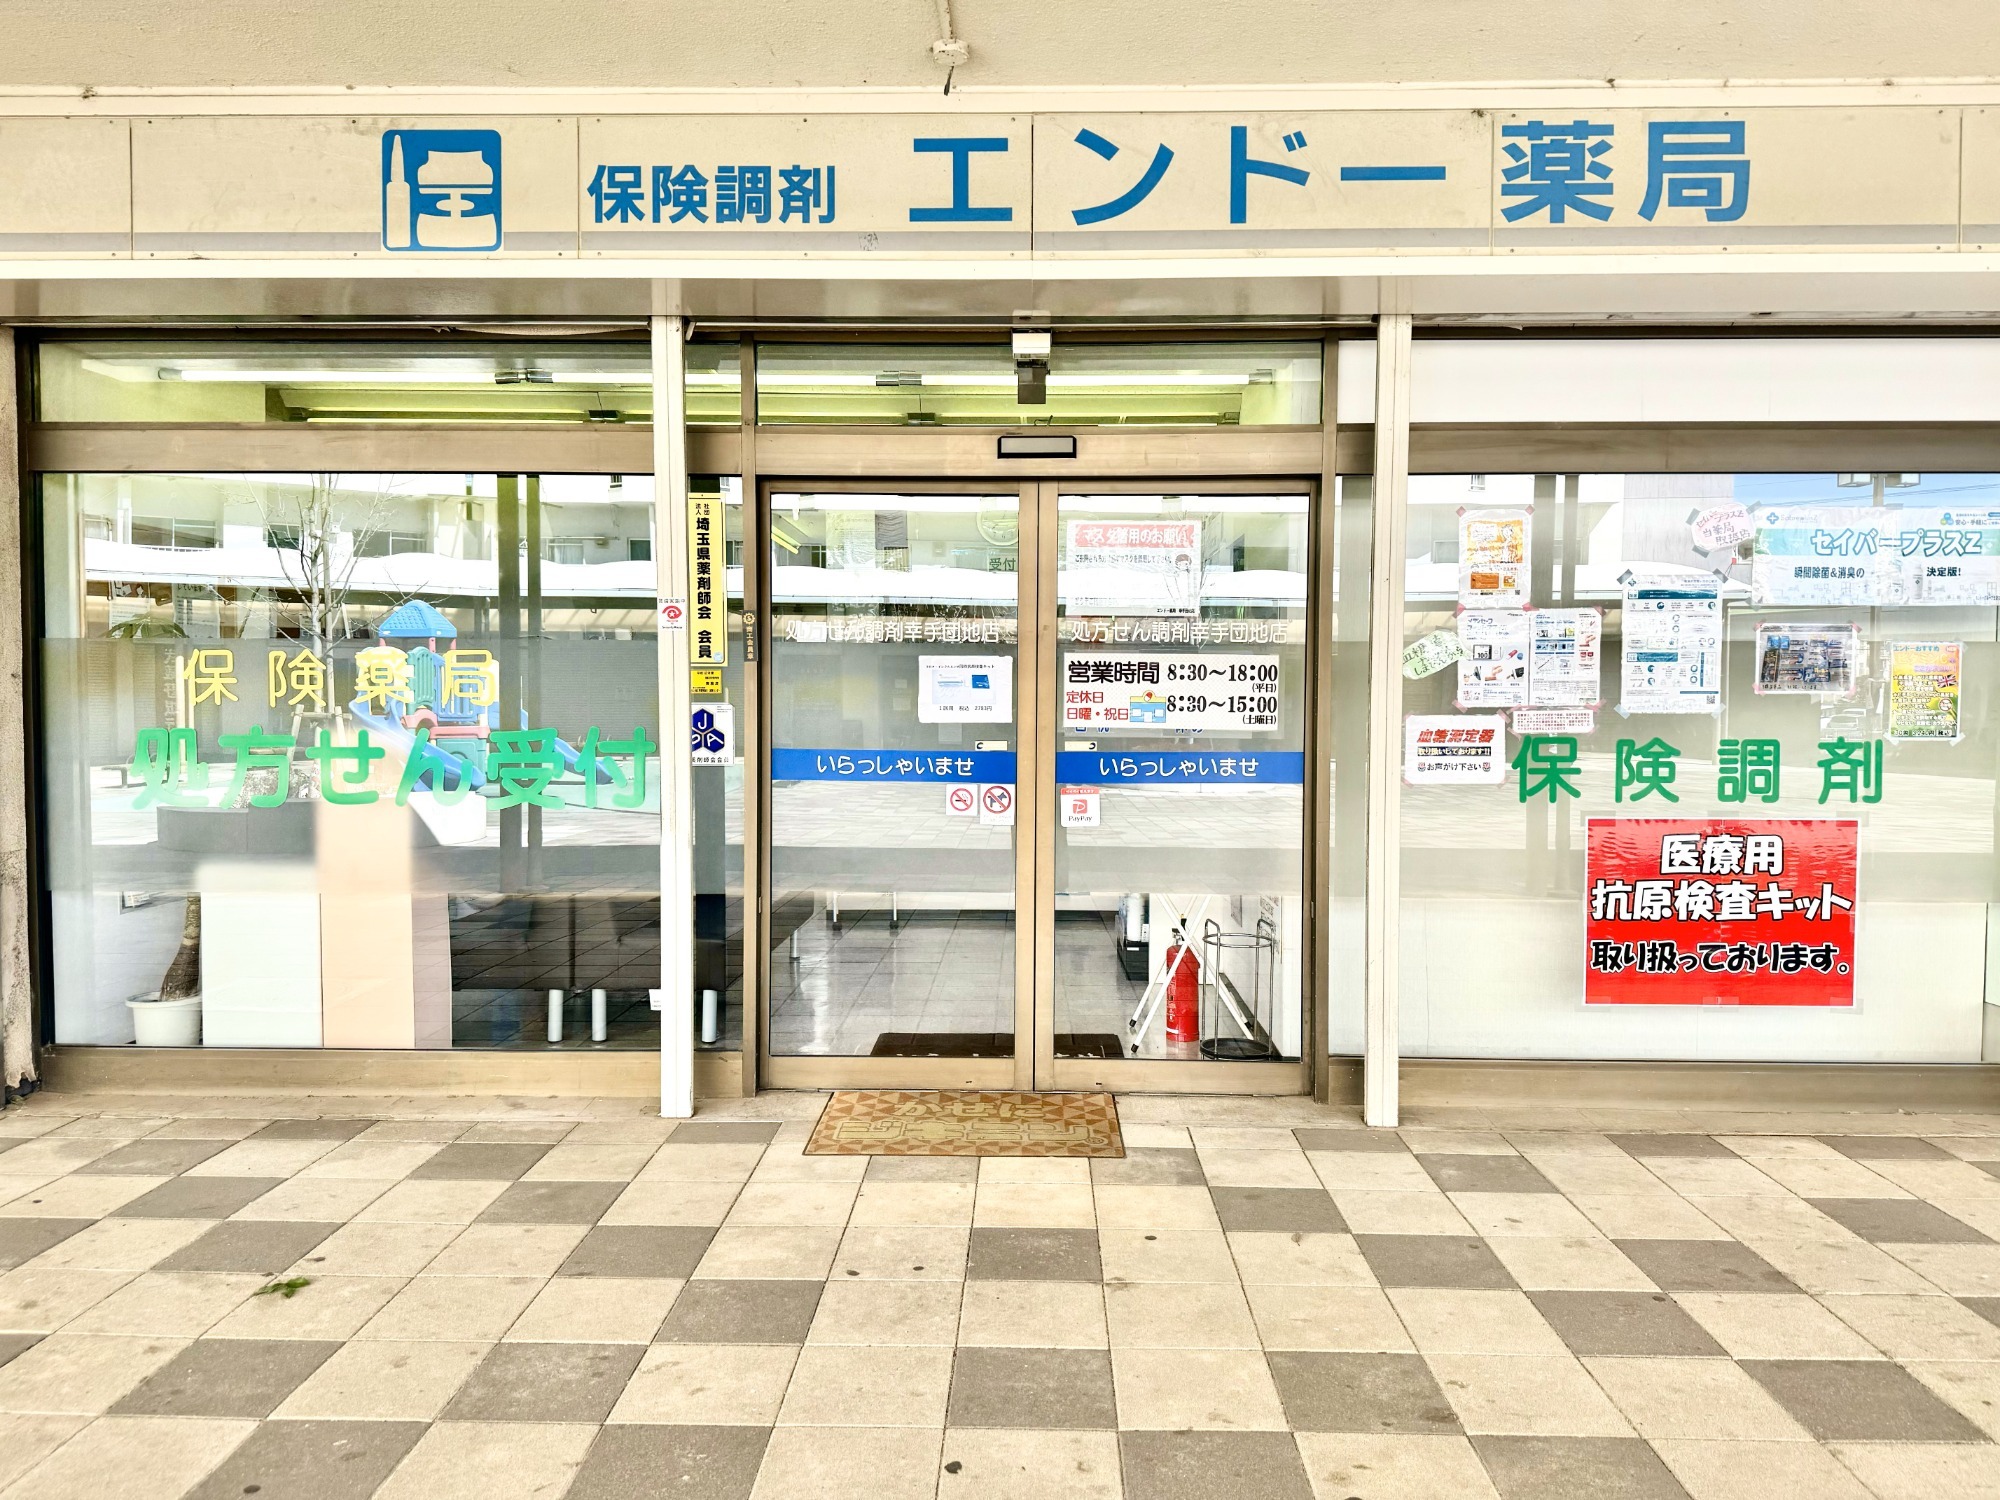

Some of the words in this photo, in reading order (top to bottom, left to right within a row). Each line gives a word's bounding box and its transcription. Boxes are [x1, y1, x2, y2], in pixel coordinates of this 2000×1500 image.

[588, 165, 836, 224] 保険調剤
[909, 120, 1750, 225] エンドー薬局
[1810, 528, 1982, 557] セイバープラスZ
[696, 517, 711, 620] 埼玉県薬剤師会
[989, 557, 1017, 571] 受付
[698, 629, 712, 659] 会員
[1071, 621, 1287, 643] 処方せん調剤幸手団地店
[183, 648, 498, 708] 保険薬局
[1068, 660, 1160, 684] 営業時間
[1066, 691, 1104, 704] 定休日
[133, 725, 657, 811] 処方せん受付
[817, 755, 975, 776] いらっしゃいませ
[1099, 757, 1259, 777] いらっしゃいませ
[1427, 762, 1482, 772] お声がけ下さい
[1511, 735, 1884, 804] 保険調剤
[1660, 833, 1785, 875] 医療用
[1590, 880, 1853, 921] 抗原検査キット
[1590, 941, 1850, 974] 取り扱っております。
